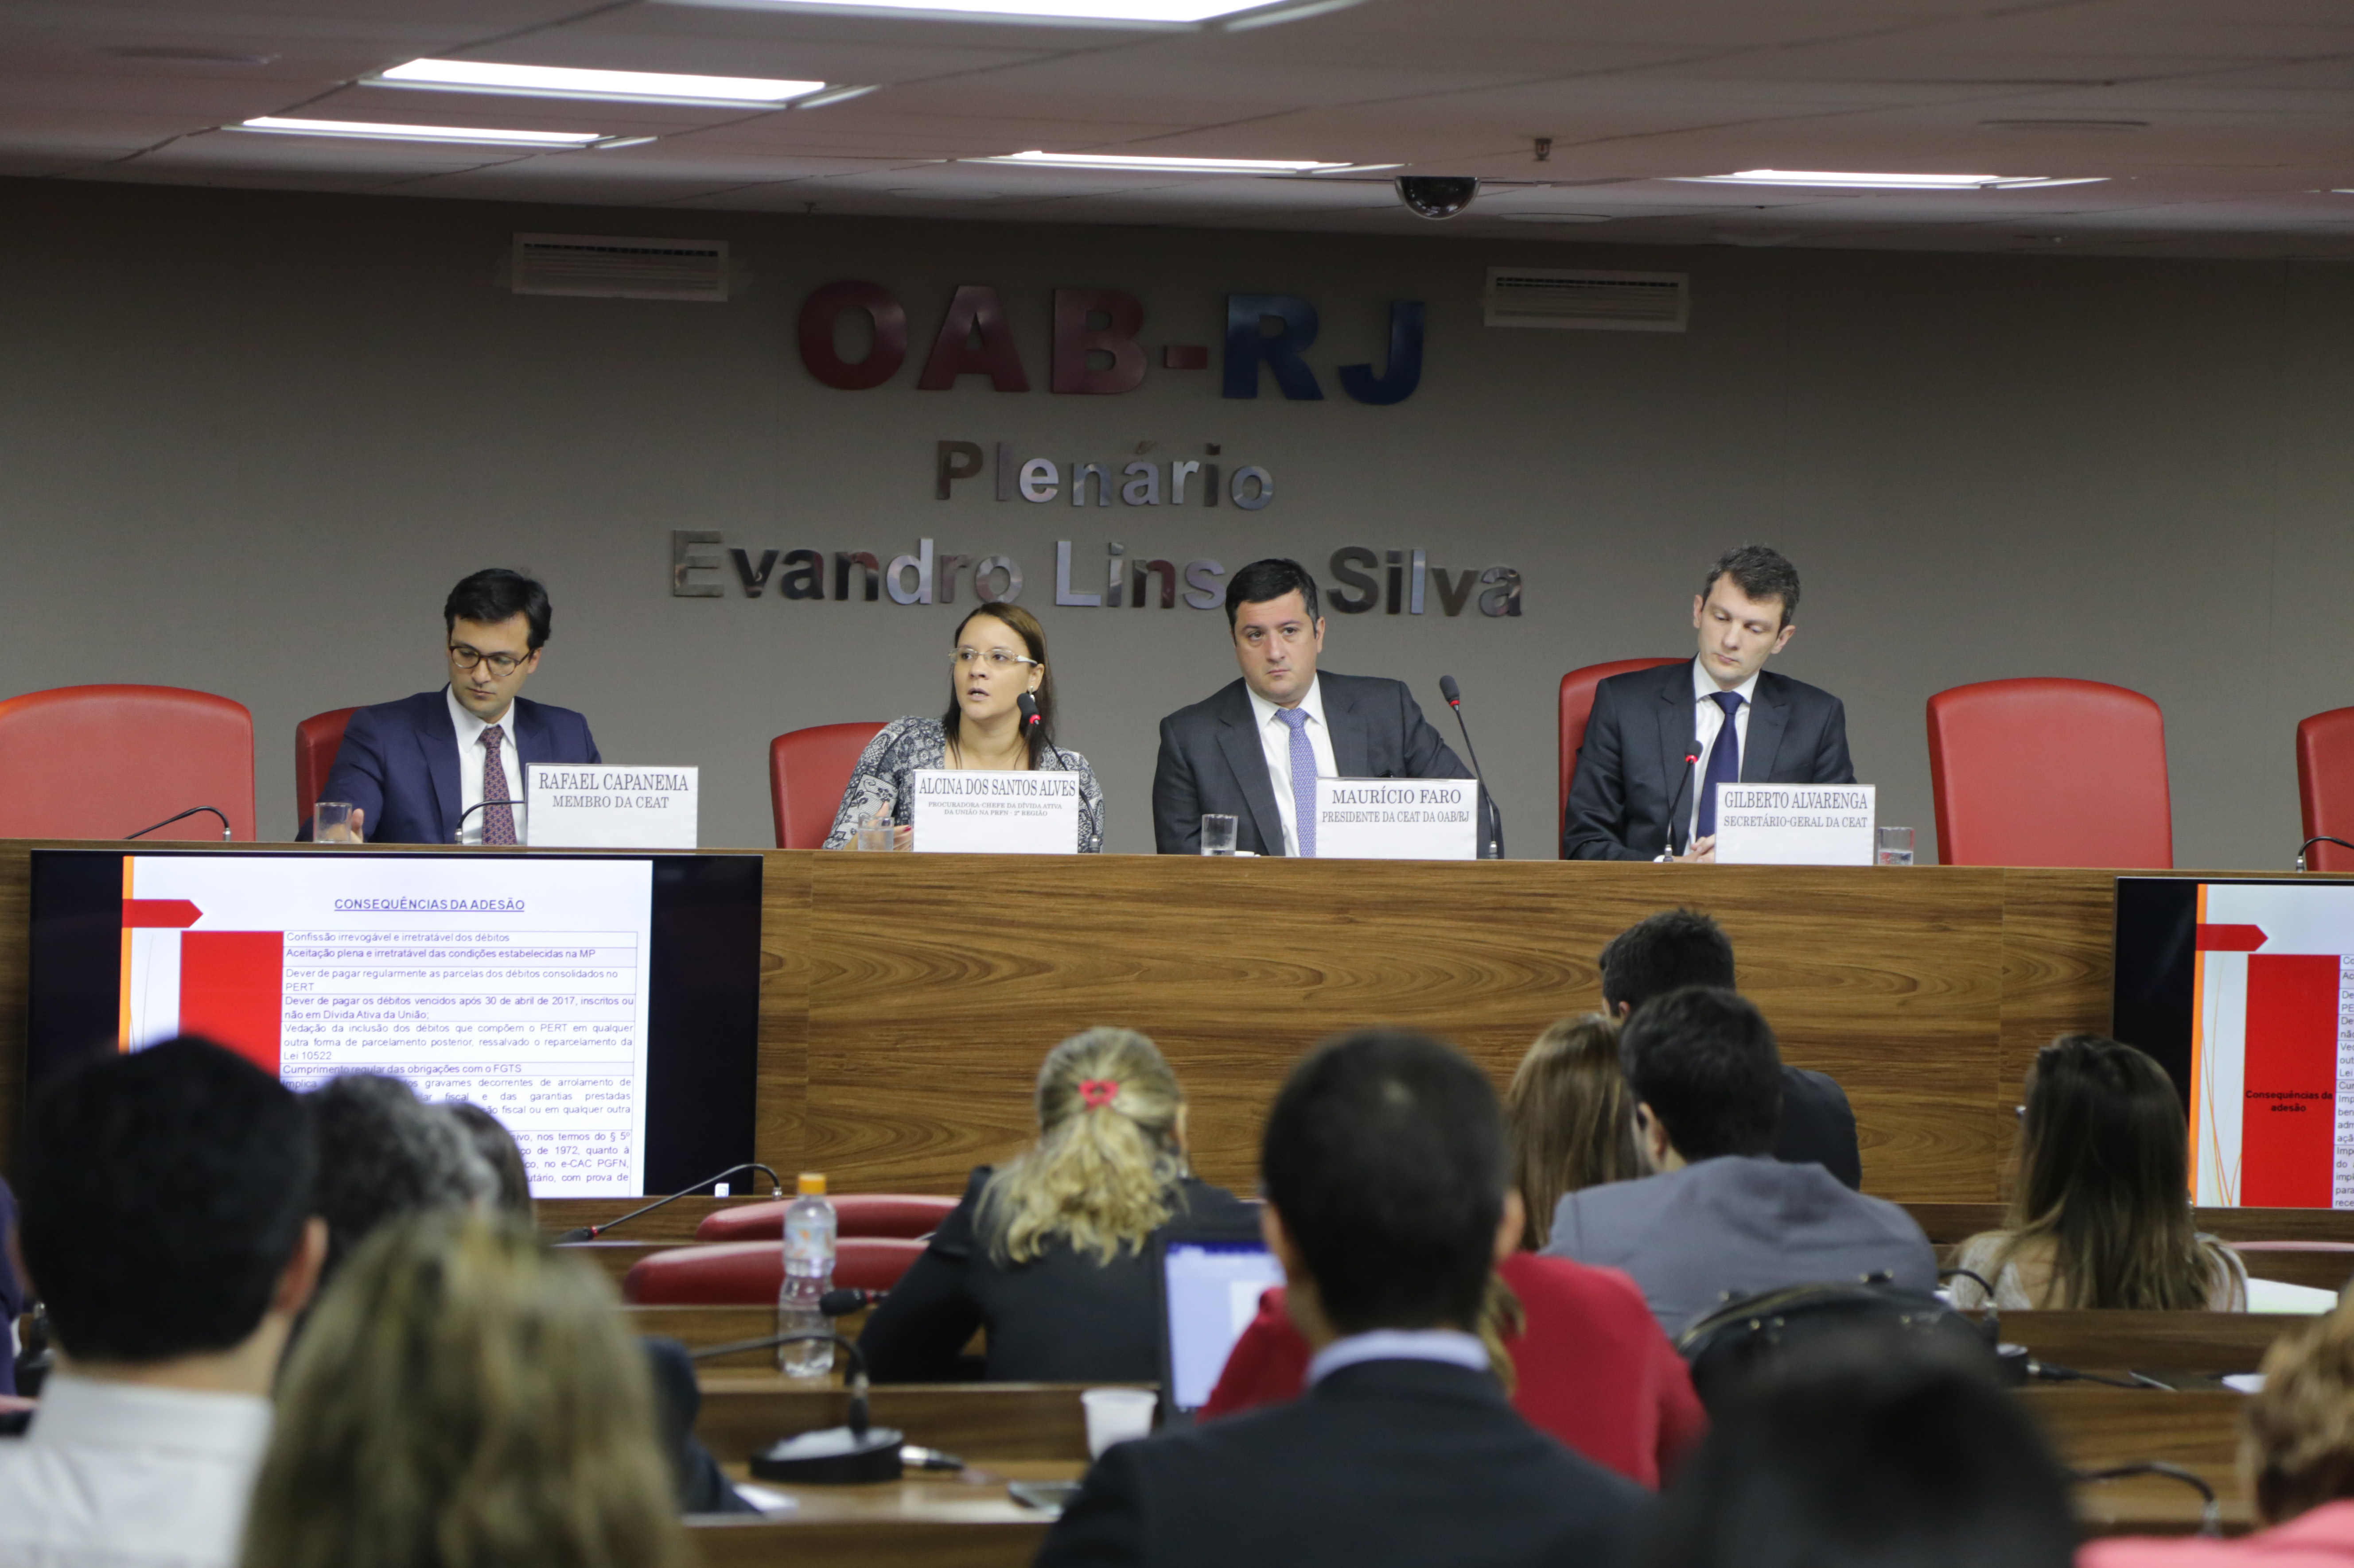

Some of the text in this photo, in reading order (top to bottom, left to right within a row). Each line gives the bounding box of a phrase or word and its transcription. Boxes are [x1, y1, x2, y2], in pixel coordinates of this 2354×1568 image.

[797, 278, 1425, 406] OAB-RJ
[935, 438, 1274, 511] Plenário
[671, 528, 1524, 617] Evandro Lins Silva
[539, 773, 689, 791] RAFAEL CAPANEMA
[919, 778, 1075, 796] ALCINA DOS SANTOS ALVES
[1332, 786, 1461, 803] MAURÍCIO FARO
[553, 796, 669, 808] MEMBRO DA CEAT
[1725, 792, 1868, 809] GILBERTO ALVARENGA
[1322, 811, 1469, 822] PRESIDENTE DA CEAT DA OAB/RJ
[1724, 814, 1868, 827] SECRETÁRIO-GERAL DA CEAT
[335, 897, 525, 910] CONSEQUÊNCIAS DA ADESÃO
[287, 931, 335, 941] Confissão
[339, 933, 391, 943] irrevogável
[286, 949, 335, 959] Aceitação
[338, 949, 364, 959] plena
[375, 947, 426, 957] irretratável
[449, 949, 496, 959] condições
[363, 970, 426, 979] regularmente
[443, 970, 483, 979] parcelas
[286, 983, 314, 991] PERT
[459, 997, 481, 1006] após
[552, 997, 577, 1005] 2017,
[285, 1010, 303, 1019] não
[324, 1010, 354, 1019] Dívida
[398, 1010, 428, 1019] União;
[285, 1024, 326, 1034] Vedação
[478, 1024, 524, 1033] compõem
[593, 1025, 633, 1033] qualquer
[362, 1038, 426, 1048] parcelamento
[431, 1039, 473, 1048] posterior,
[545, 1038, 616, 1047] reparcelamento
[283, 1065, 350, 1075] Cumprimento
[386, 1065, 405, 1074] das
[408, 1065, 459, 1075] obrigações
[425, 1080, 471, 1089] gravames
[530, 1093, 572, 1102] garantias
[585, 1092, 630, 1101] prestadas
[2246, 1091, 2319, 1100] Consequências
[563, 1106, 603, 1115] qualquer
[611, 1132, 615, 1142] §
[556, 1146, 580, 1155] 1972,
[586, 1146, 618, 1156] quanto
[561, 1159, 591, 1168] e-CAC
[597, 1159, 629, 1168] PGFN,
